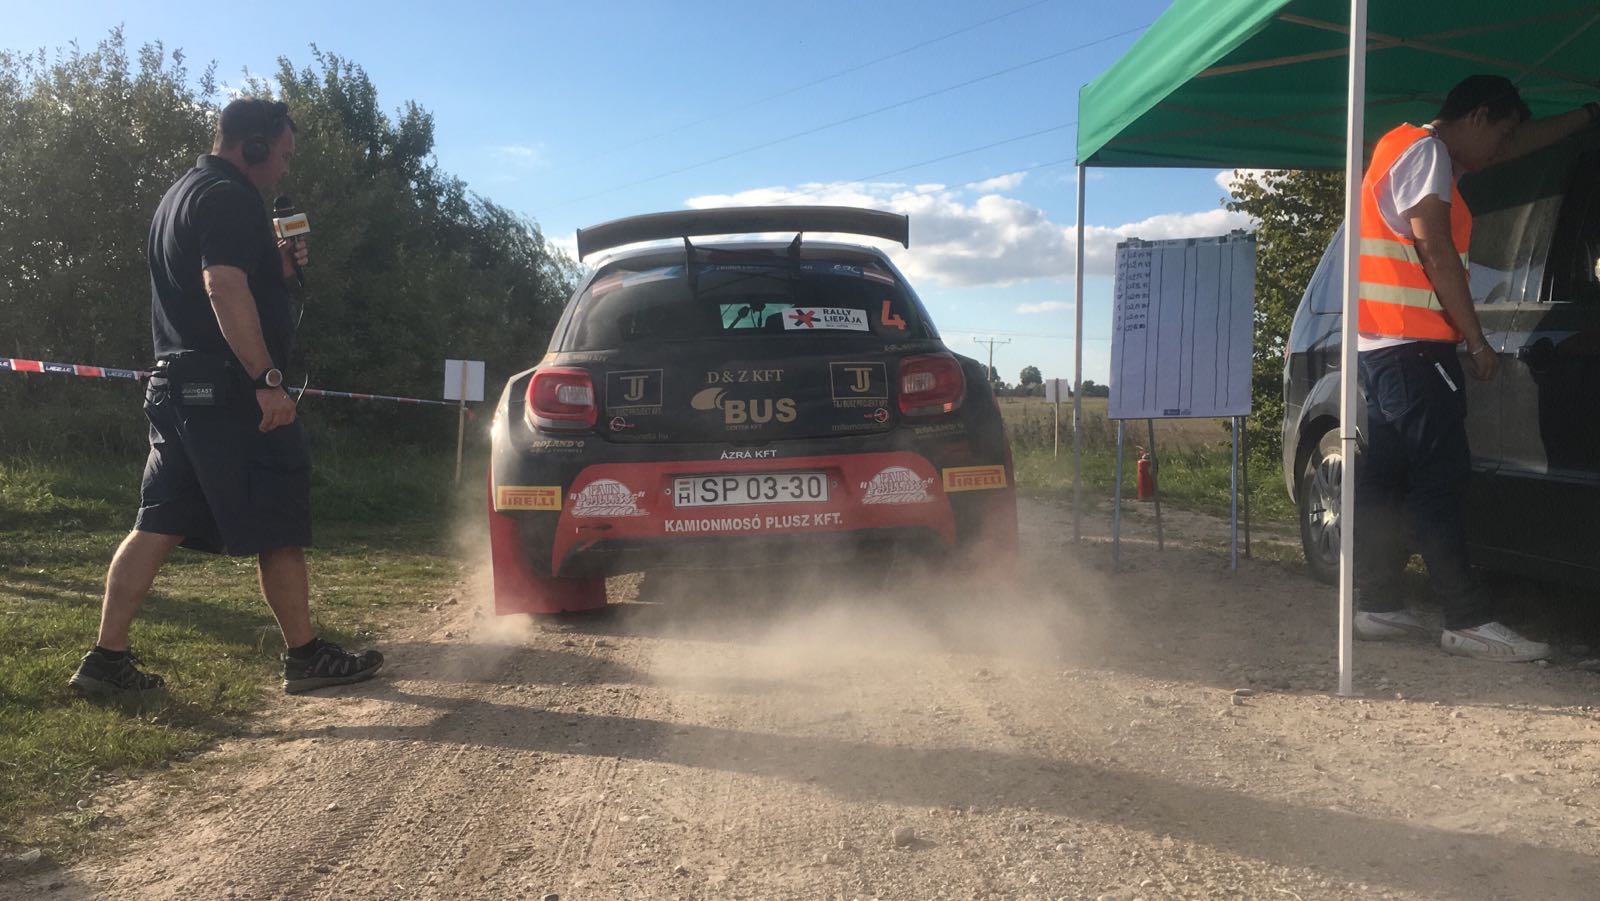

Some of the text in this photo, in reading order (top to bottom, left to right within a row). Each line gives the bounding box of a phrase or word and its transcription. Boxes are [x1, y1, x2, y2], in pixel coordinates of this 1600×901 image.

[823, 308, 852, 319] RALLY
[881, 300, 906, 330] 4
[707, 369, 784, 384] D & Z KFT
[725, 397, 798, 424] BUS
[755, 449, 777, 459] KFT
[949, 469, 1001, 487] PIRELLI
[502, 489, 556, 506] PIRELLI
[589, 483, 620, 495] PAIN
[678, 475, 822, 505] H SP 03-30
[664, 512, 843, 532] KAMIONMOSÓ PLUSZ KFT.
